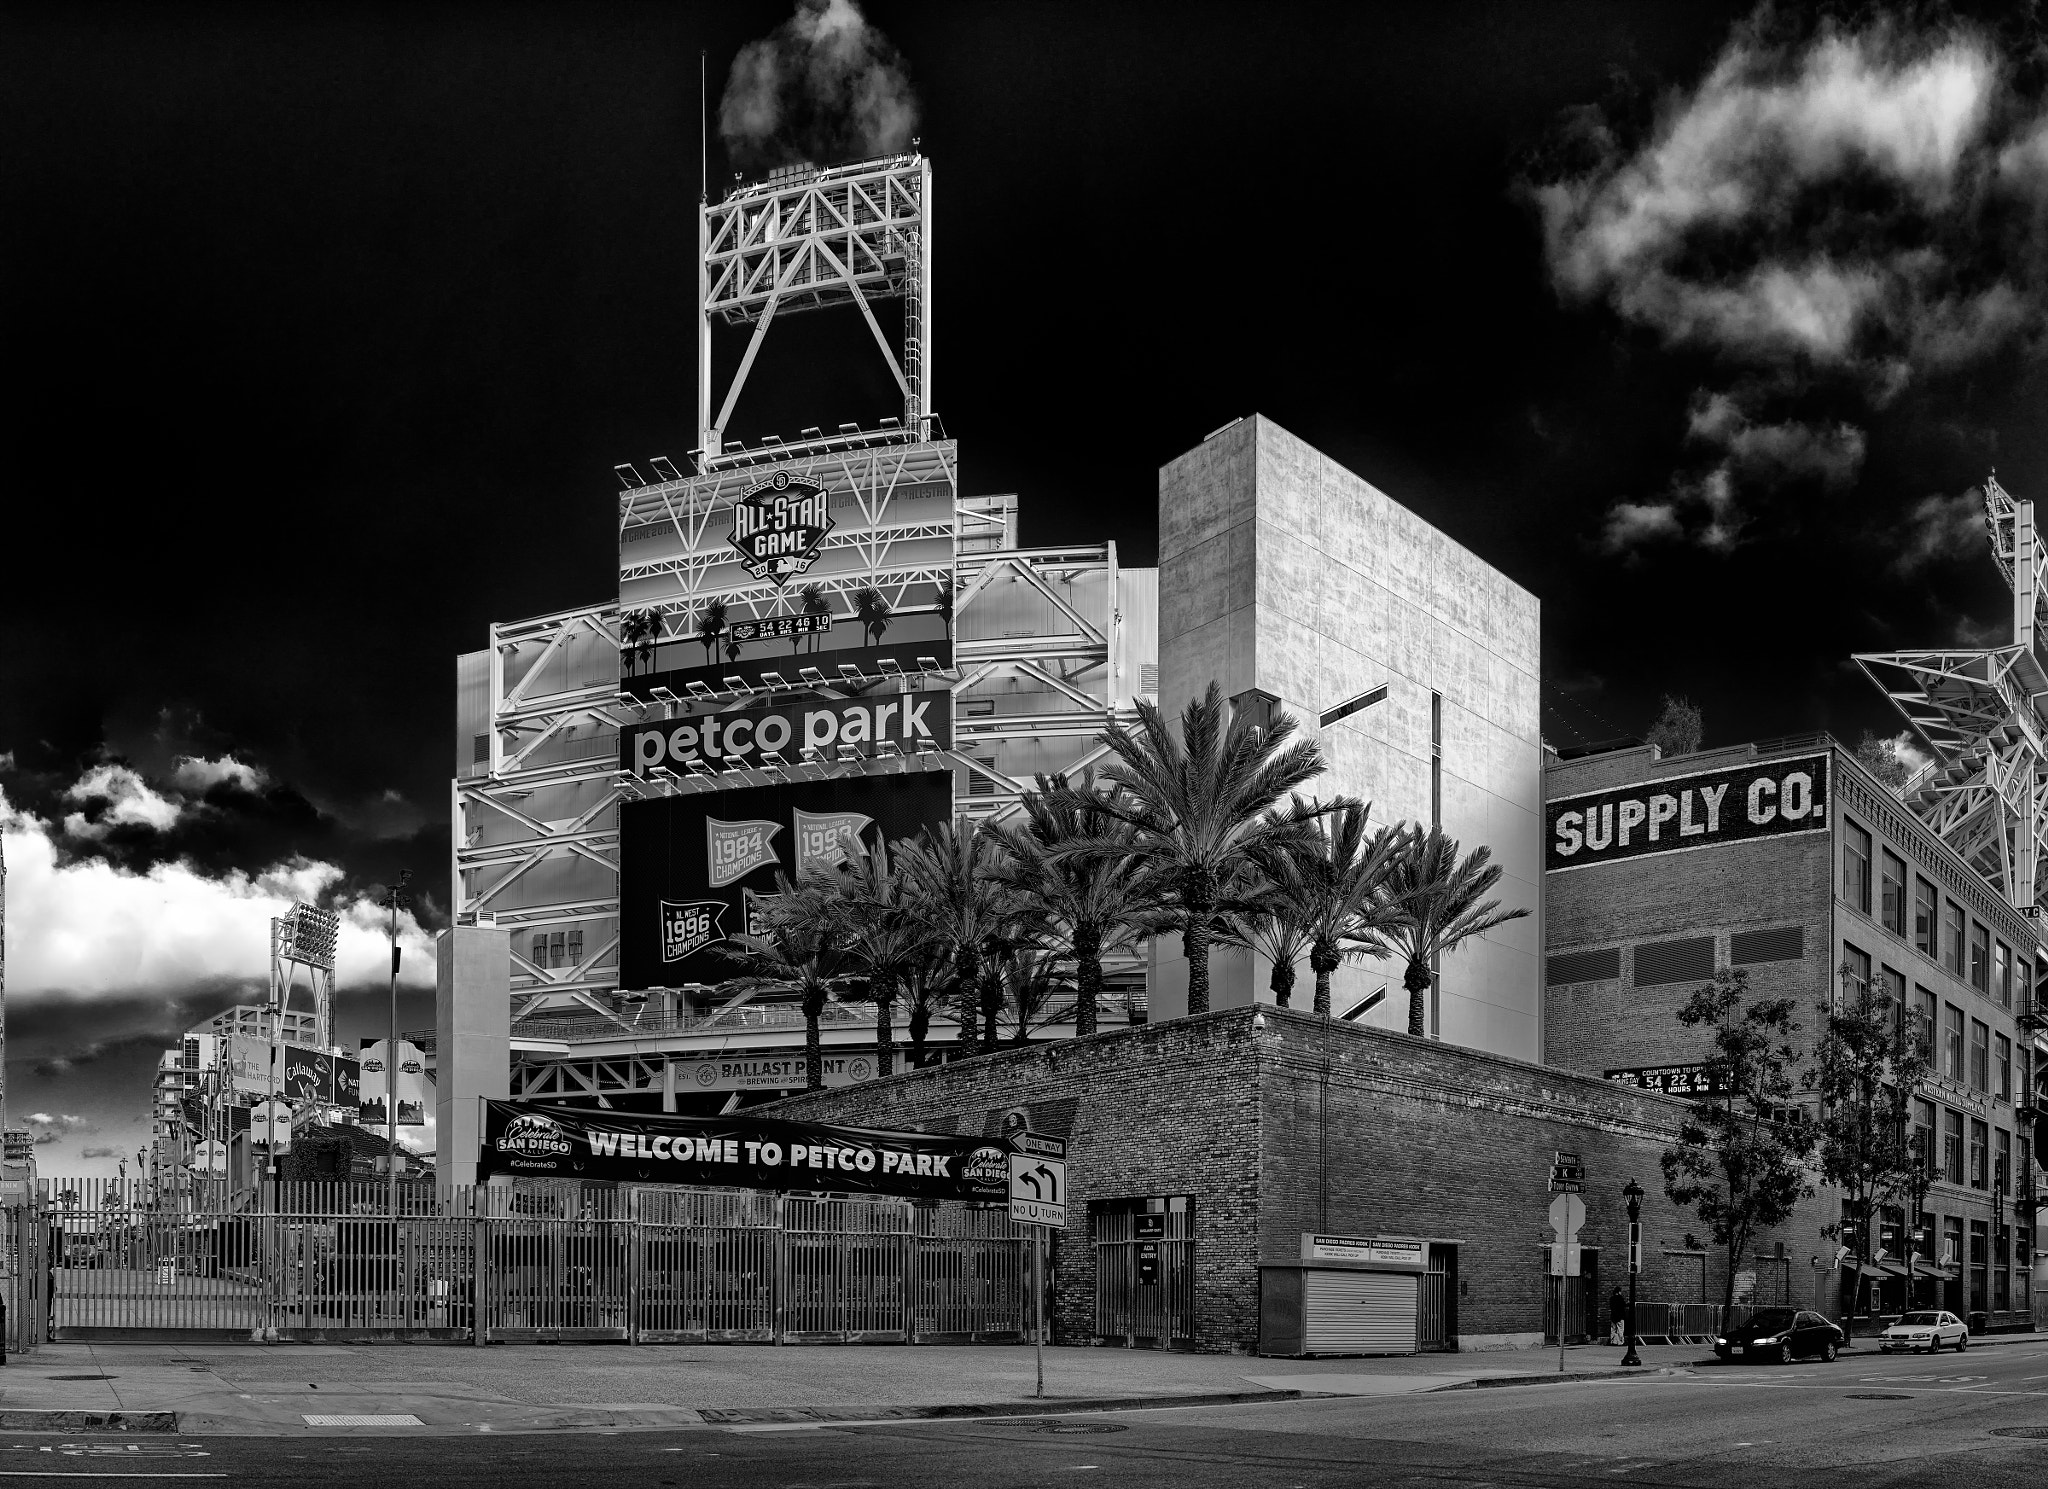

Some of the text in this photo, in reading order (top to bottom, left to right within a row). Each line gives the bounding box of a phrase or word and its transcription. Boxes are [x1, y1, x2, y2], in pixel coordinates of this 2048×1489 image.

[754, 529, 807, 557] GAME
[755, 561, 806, 575] 20 16
[760, 622, 774, 632] 54
[778, 619, 793, 630] 22
[795, 617, 811, 627] 46
[815, 615, 829, 626] 10
[634, 694, 933, 778] petco park
[1555, 771, 1824, 857] SUPPLY CO.
[715, 832, 763, 865] 1984
[716, 850, 762, 879] CHAMPIONS
[684, 907, 700, 919] WEST
[666, 913, 710, 944] 1996
[667, 930, 710, 957] CHAMPIONS
[247, 1061, 260, 1071] THE
[285, 1060, 321, 1087] Callaway
[721, 1060, 846, 1078] BALLAST PNT
[1642, 1067, 1681, 1077] COUNTDOWN
[1682, 1066, 1691, 1074] TO
[746, 1077, 779, 1086] BREWING
[1646, 1075, 1662, 1088] 54
[1671, 1074, 1688, 1086] 22
[1668, 1085, 1691, 1093] HOURS
[1696, 1084, 1709, 1092] MIN
[508, 1125, 560, 1139] Celebrate
[498, 1138, 569, 1153] SAN DIEGO
[1026, 1138, 1061, 1153] ONE WAY
[587, 1131, 951, 1178] WELCOME TO PETCO PARK
[510, 1159, 557, 1169] #CelebrateSD
[970, 1157, 1008, 1170] Celebrate
[963, 1167, 983, 1178] SAN
[1562, 1168, 1568, 1178] K
[1013, 1204, 1063, 1220] NO U TURN
